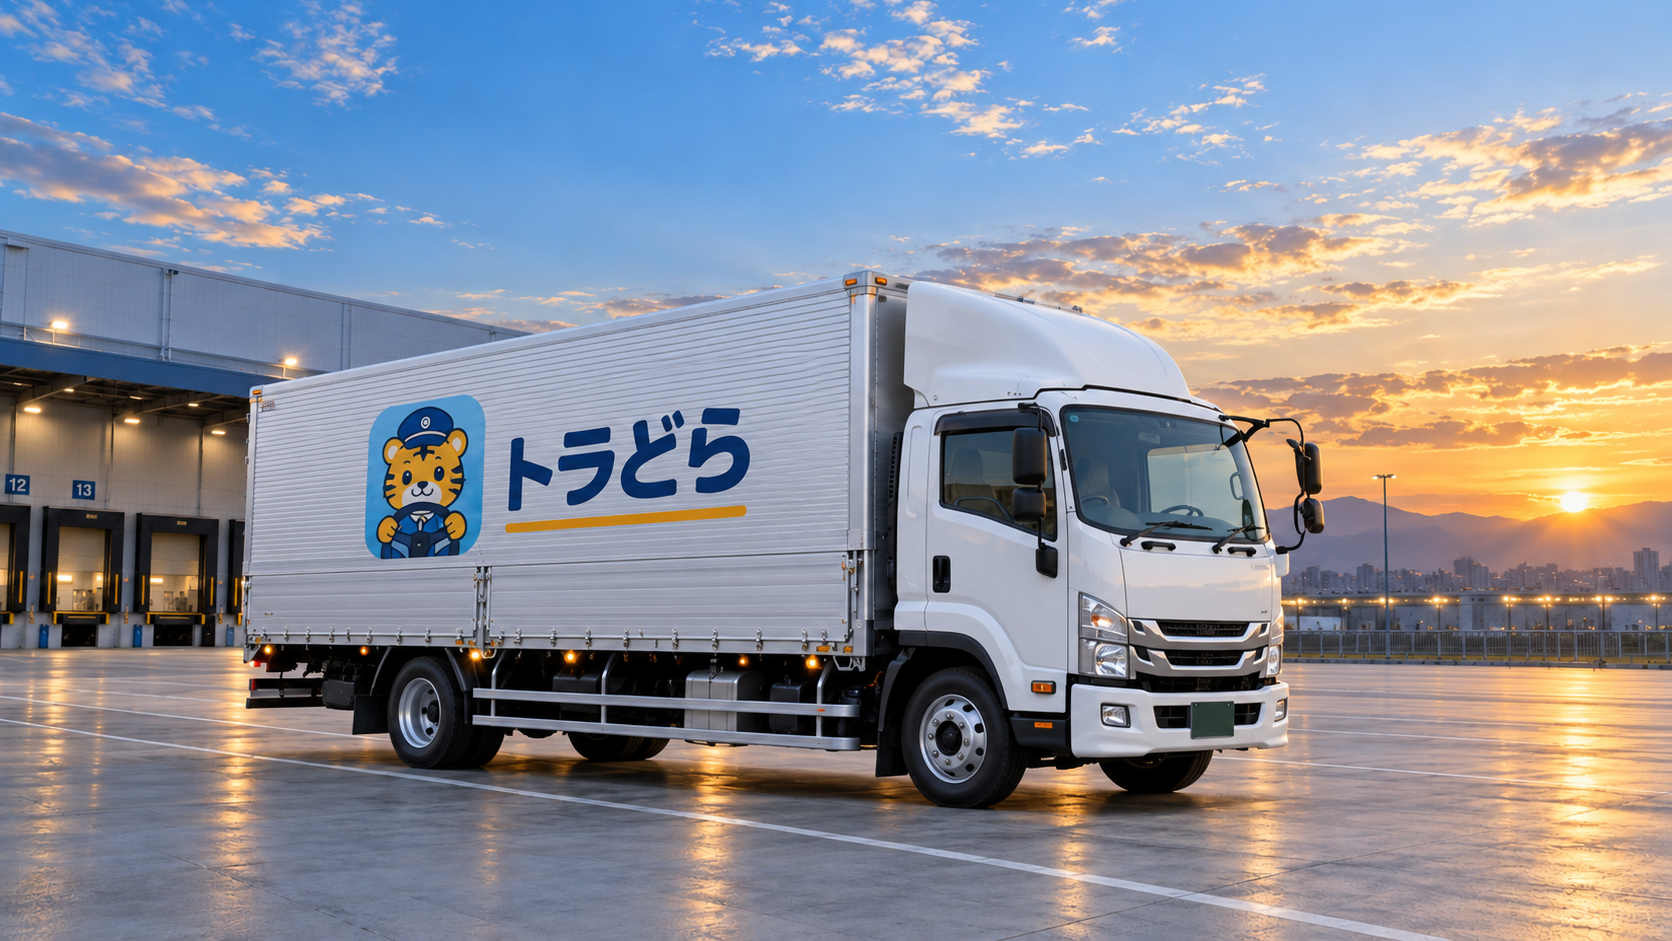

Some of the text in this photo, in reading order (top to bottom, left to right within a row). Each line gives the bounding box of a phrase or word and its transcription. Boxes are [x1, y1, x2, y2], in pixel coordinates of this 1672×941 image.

[508, 408, 750, 511] トラどら
[9, 478, 26, 492] 12
[76, 484, 92, 497] 13
